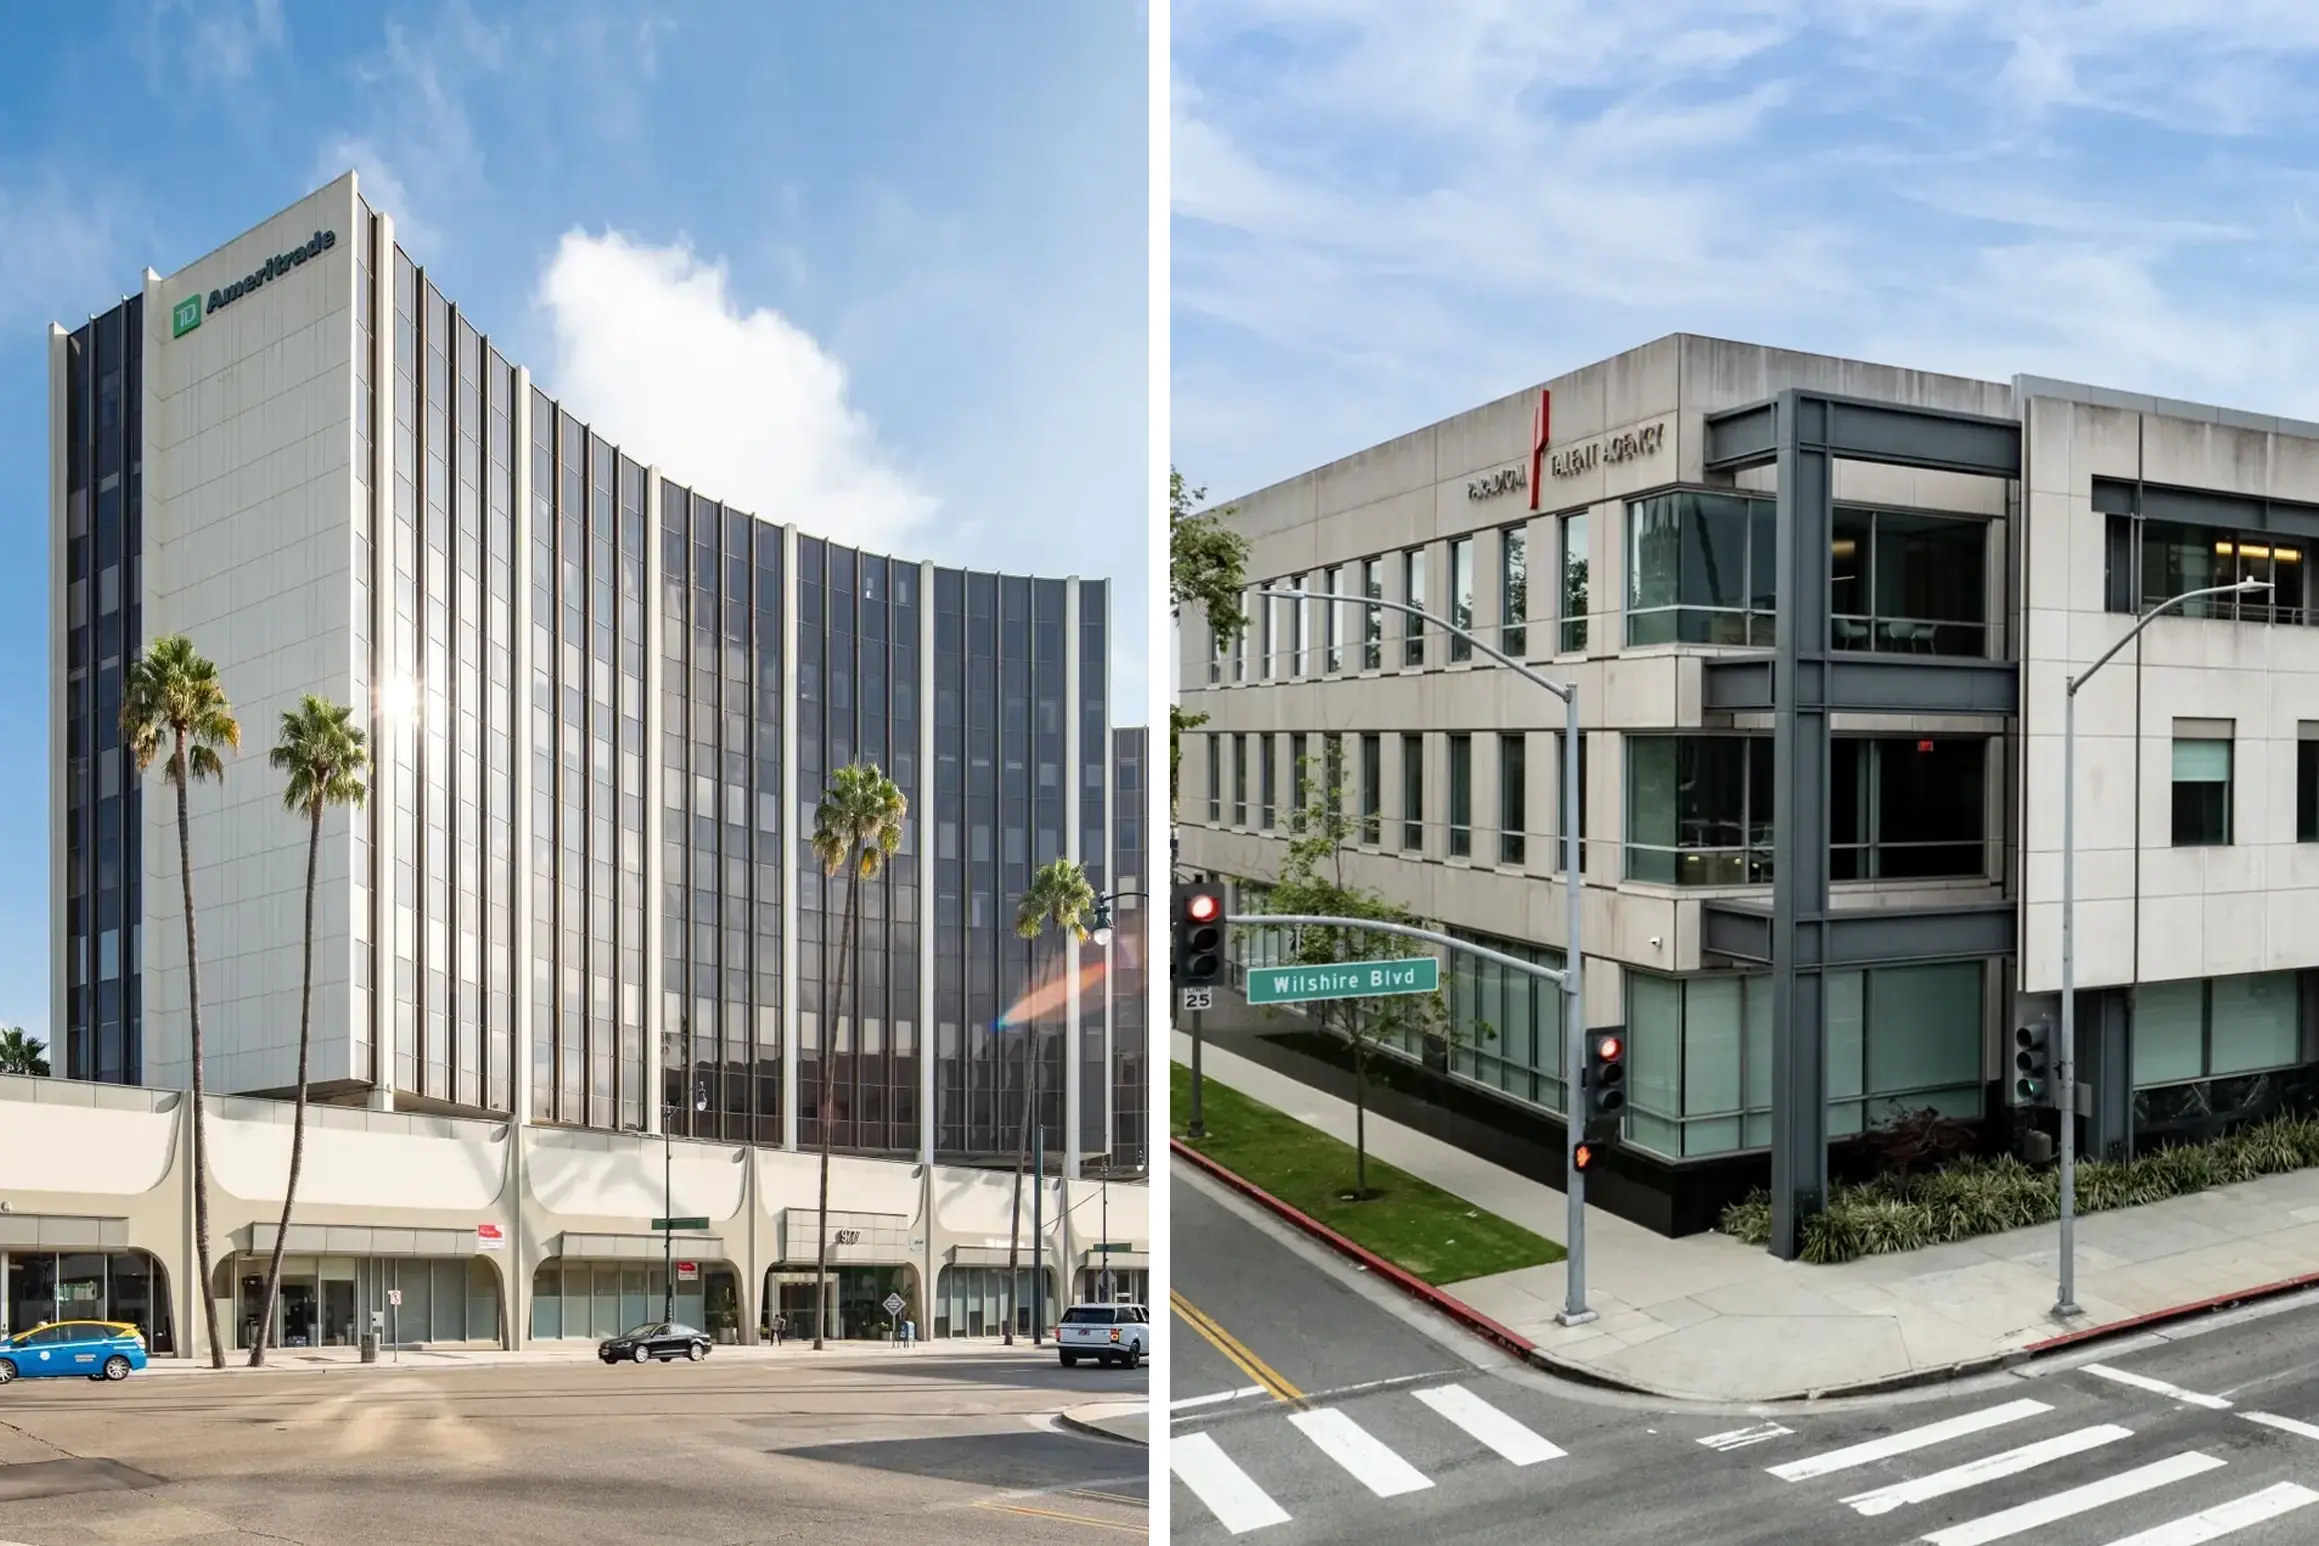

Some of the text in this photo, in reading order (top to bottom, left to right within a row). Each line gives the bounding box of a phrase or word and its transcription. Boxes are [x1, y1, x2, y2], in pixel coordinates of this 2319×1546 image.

[176, 230, 336, 328] TD Ameritrade
[1551, 443, 1600, 478] TALENT
[1603, 422, 1665, 464] AGENCY
[1186, 994, 1210, 1007] 25
[1274, 968, 1415, 994] Wilshire Blvd
